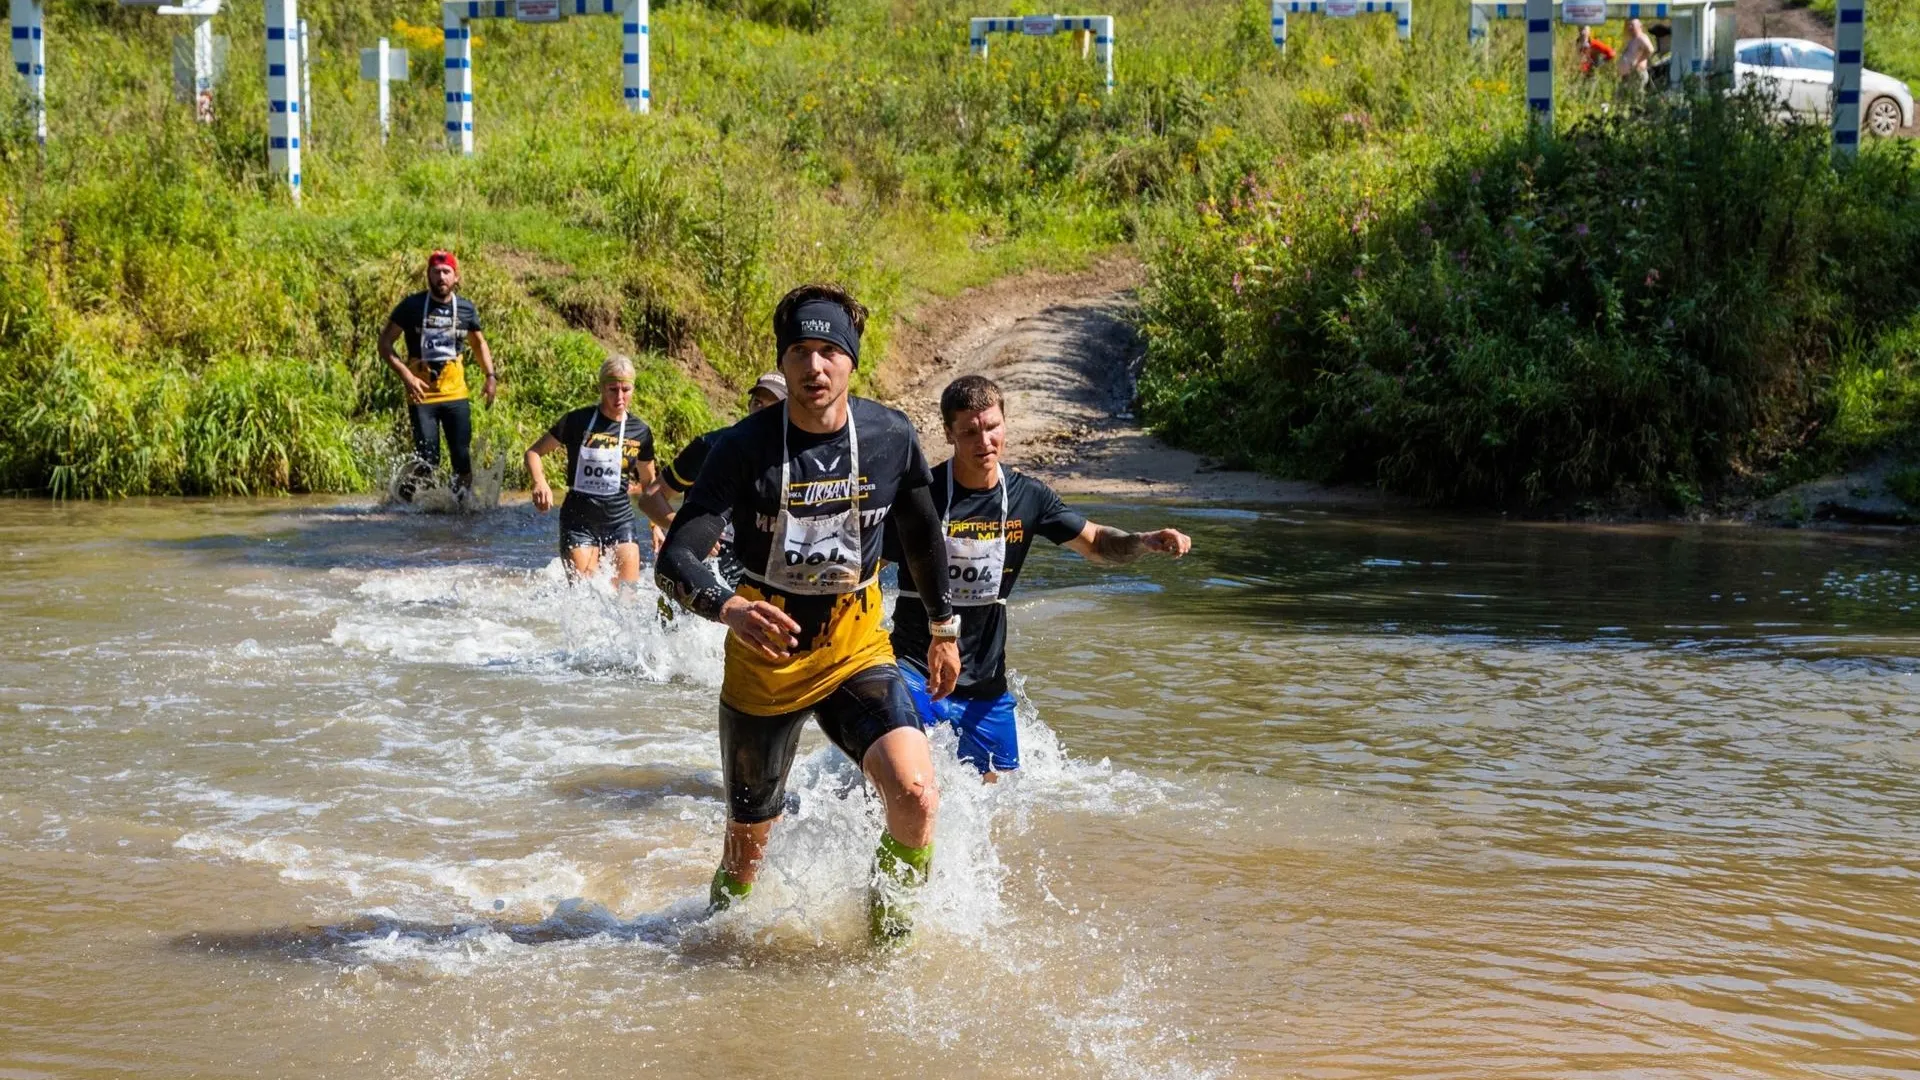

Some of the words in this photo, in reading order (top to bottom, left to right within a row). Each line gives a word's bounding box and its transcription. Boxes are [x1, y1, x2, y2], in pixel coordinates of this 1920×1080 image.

[584, 465, 614, 478] 004
[804, 473, 852, 507] URBAN
[785, 548, 848, 566] 004
[948, 565, 992, 583] 004
